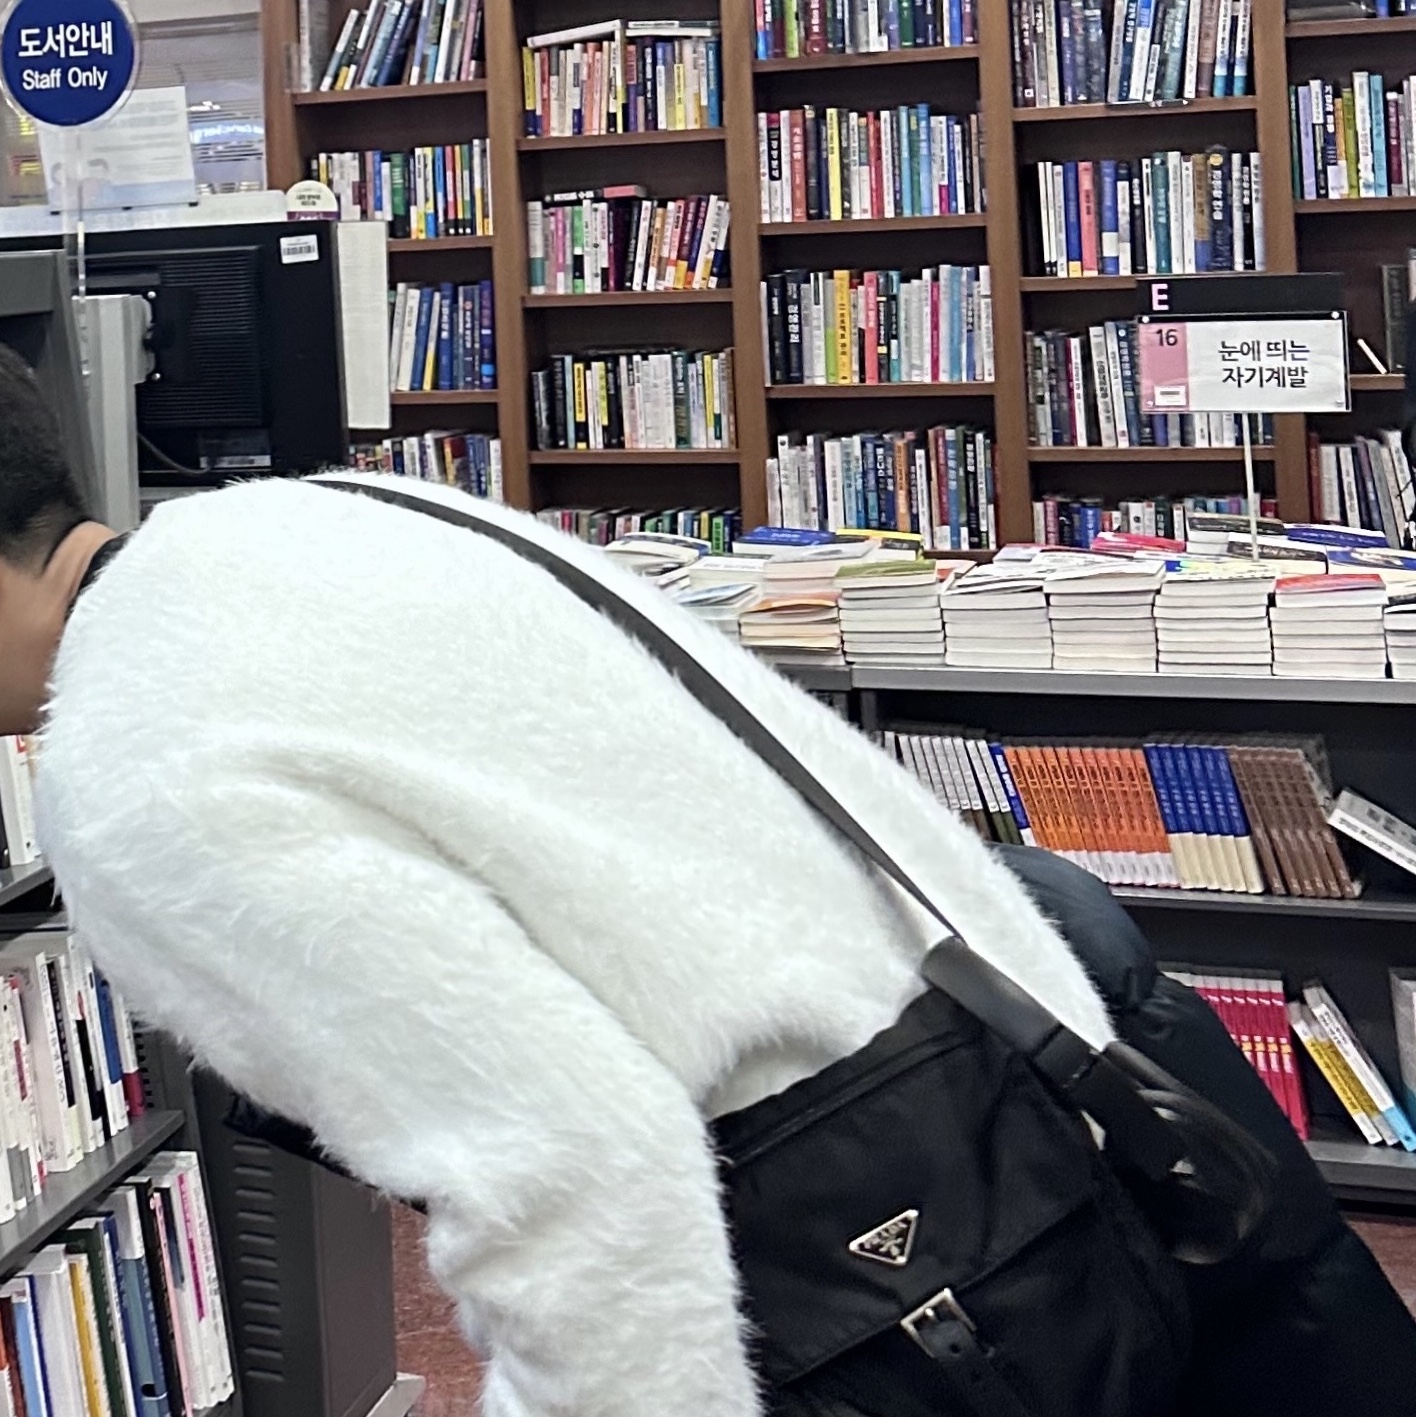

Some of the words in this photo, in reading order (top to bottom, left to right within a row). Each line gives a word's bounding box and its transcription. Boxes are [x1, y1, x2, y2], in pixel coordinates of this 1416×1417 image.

[18, 21, 113, 58] 도서안내
[22, 68, 62, 91] Staff
[67, 66, 108, 90] Only
[1150, 283, 1170, 311] E
[1155, 328, 1179, 347] 16
[1218, 340, 1261, 362] 눈에
[1266, 339, 1311, 362] 띄는
[1221, 366, 1310, 389] 자기계발
